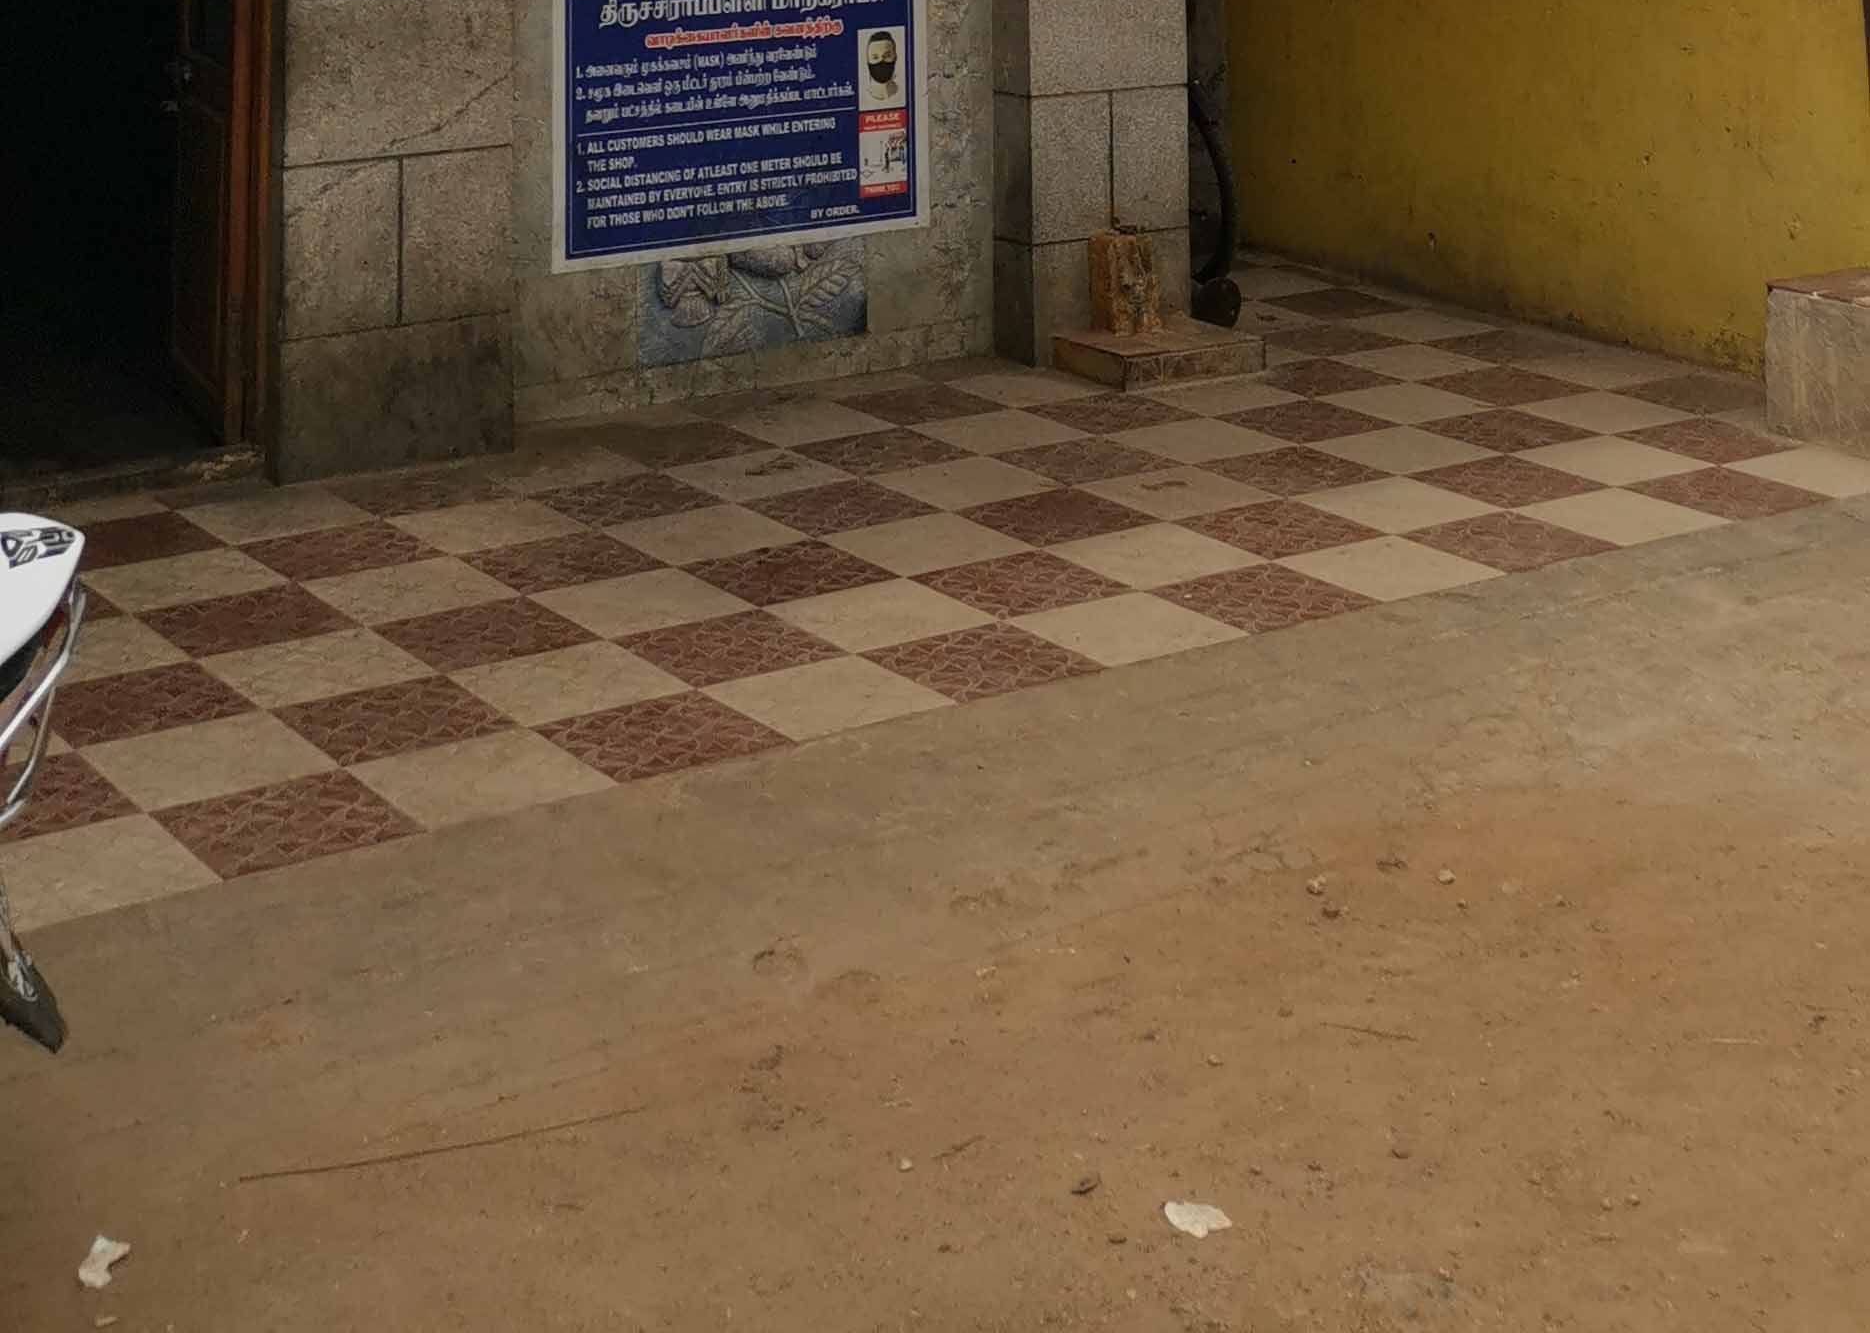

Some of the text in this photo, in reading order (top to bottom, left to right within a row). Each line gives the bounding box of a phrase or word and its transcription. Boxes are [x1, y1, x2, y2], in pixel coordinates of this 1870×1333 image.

[587, 141, 605, 154] ALL
[607, 135, 665, 152] CUSTOMERS
[667, 130, 704, 145] SHOULD
[706, 127, 733, 141] WEAR
[734, 124, 761, 139] MASK
[761, 121, 791, 136] WHILE
[792, 117, 836, 133] ENTERING
[587, 156, 638, 173] THE SHOP.
[587, 177, 622, 192] SOCIAL
[624, 170, 681, 188] DISTANCING
[683, 167, 696, 181] OF
[698, 163, 738, 179] ATLEAST
[739, 160, 759, 175] ONE
[761, 157, 791, 171] METER
[792, 153, 829, 167] SHOULD
[830, 151, 842, 165] BE
[587, 168, 858, 211] MAINTAINED BY EVERYONE. ENTRY IS STRICTLY PROHIBITED
[587, 215, 606, 229] FOR
[608, 211, 641, 227] THOSE
[641, 208, 665, 222] WHO
[666, 204, 695, 220] DON'T
[697, 200, 734, 215] FOLLOW
[736, 197, 755, 212] THE
[810, 208, 824, 219] BY
